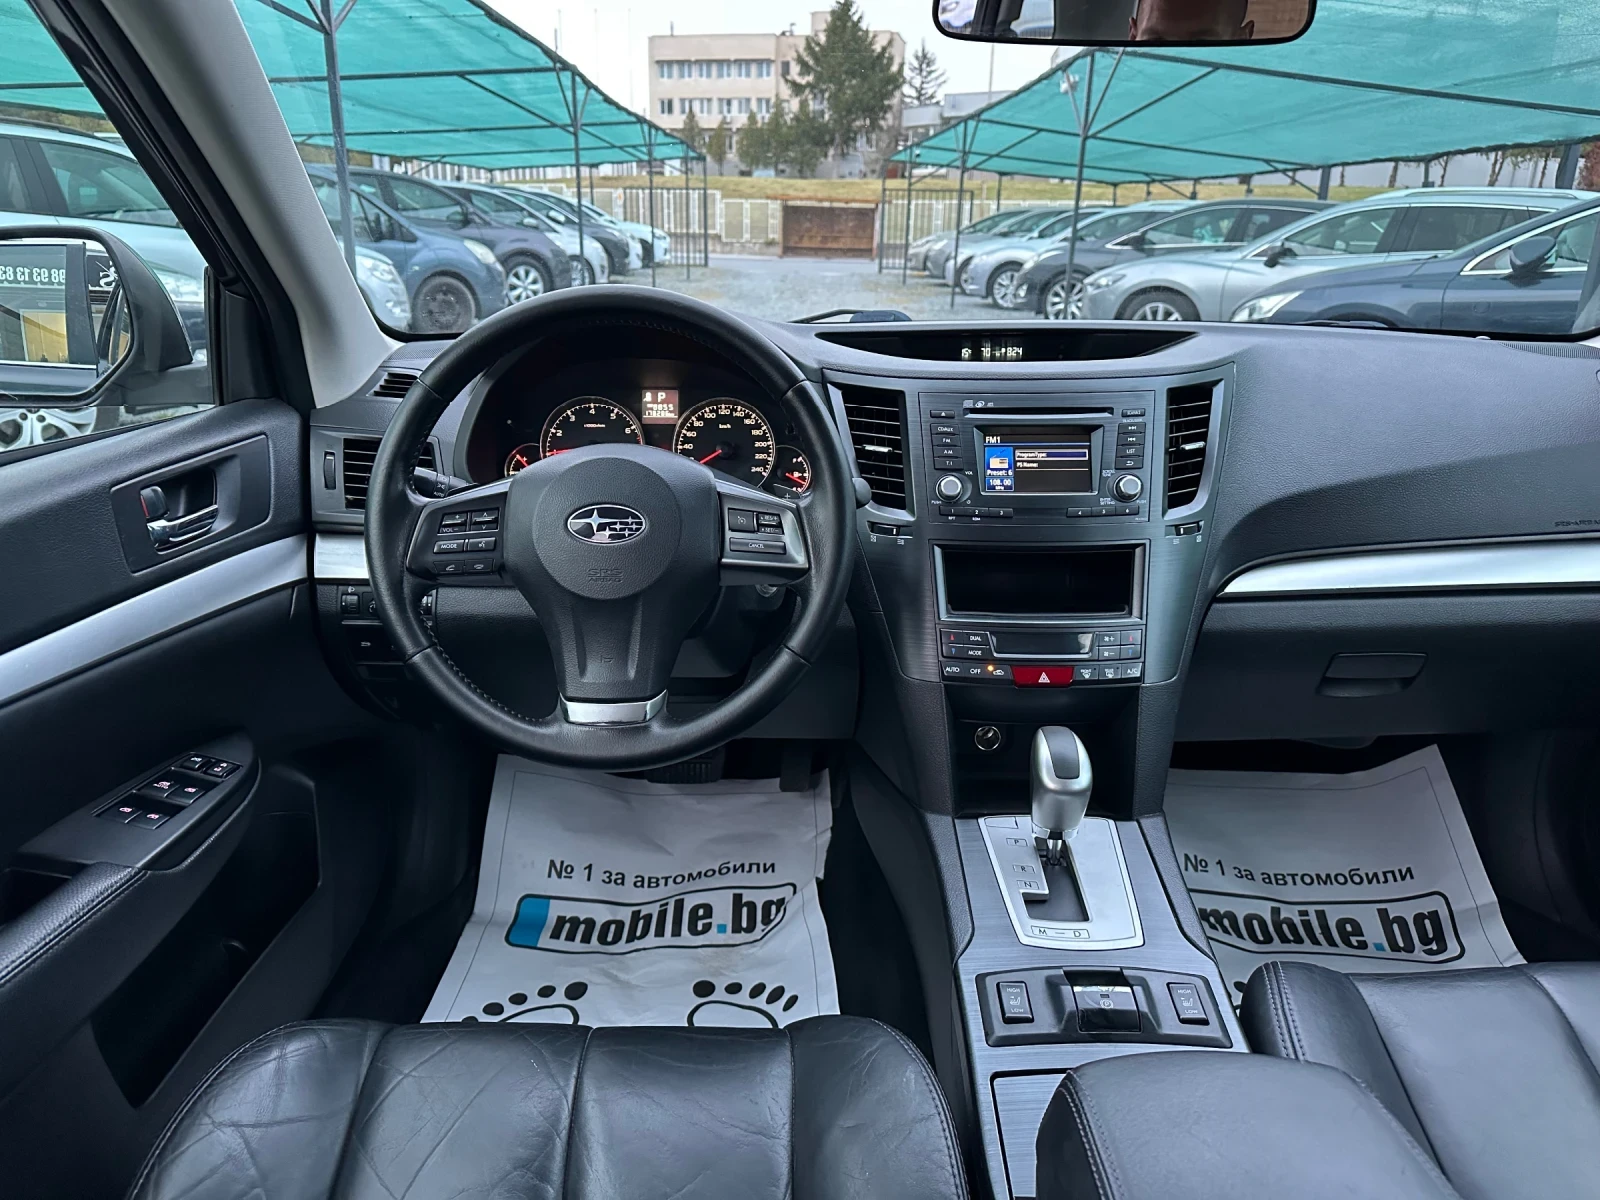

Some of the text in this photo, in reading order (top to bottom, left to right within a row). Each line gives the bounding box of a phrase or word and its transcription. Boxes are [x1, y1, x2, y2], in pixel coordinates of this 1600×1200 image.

[657, 392, 666, 402] P
[569, 414, 576, 422] 3
[985, 436, 1001, 444] FM1
[587, 568, 622, 578] SRS
[583, 863, 593, 882] 1
[601, 870, 625, 886] за
[633, 861, 776, 889] автомобили
[1215, 860, 1225, 876] 1
[1232, 866, 1256, 882] за
[1261, 866, 1415, 886] автомобили
[550, 893, 786, 946] mobile.bg
[1038, 928, 1081, 938] M D
[1198, 905, 1448, 957] mobile.bg
